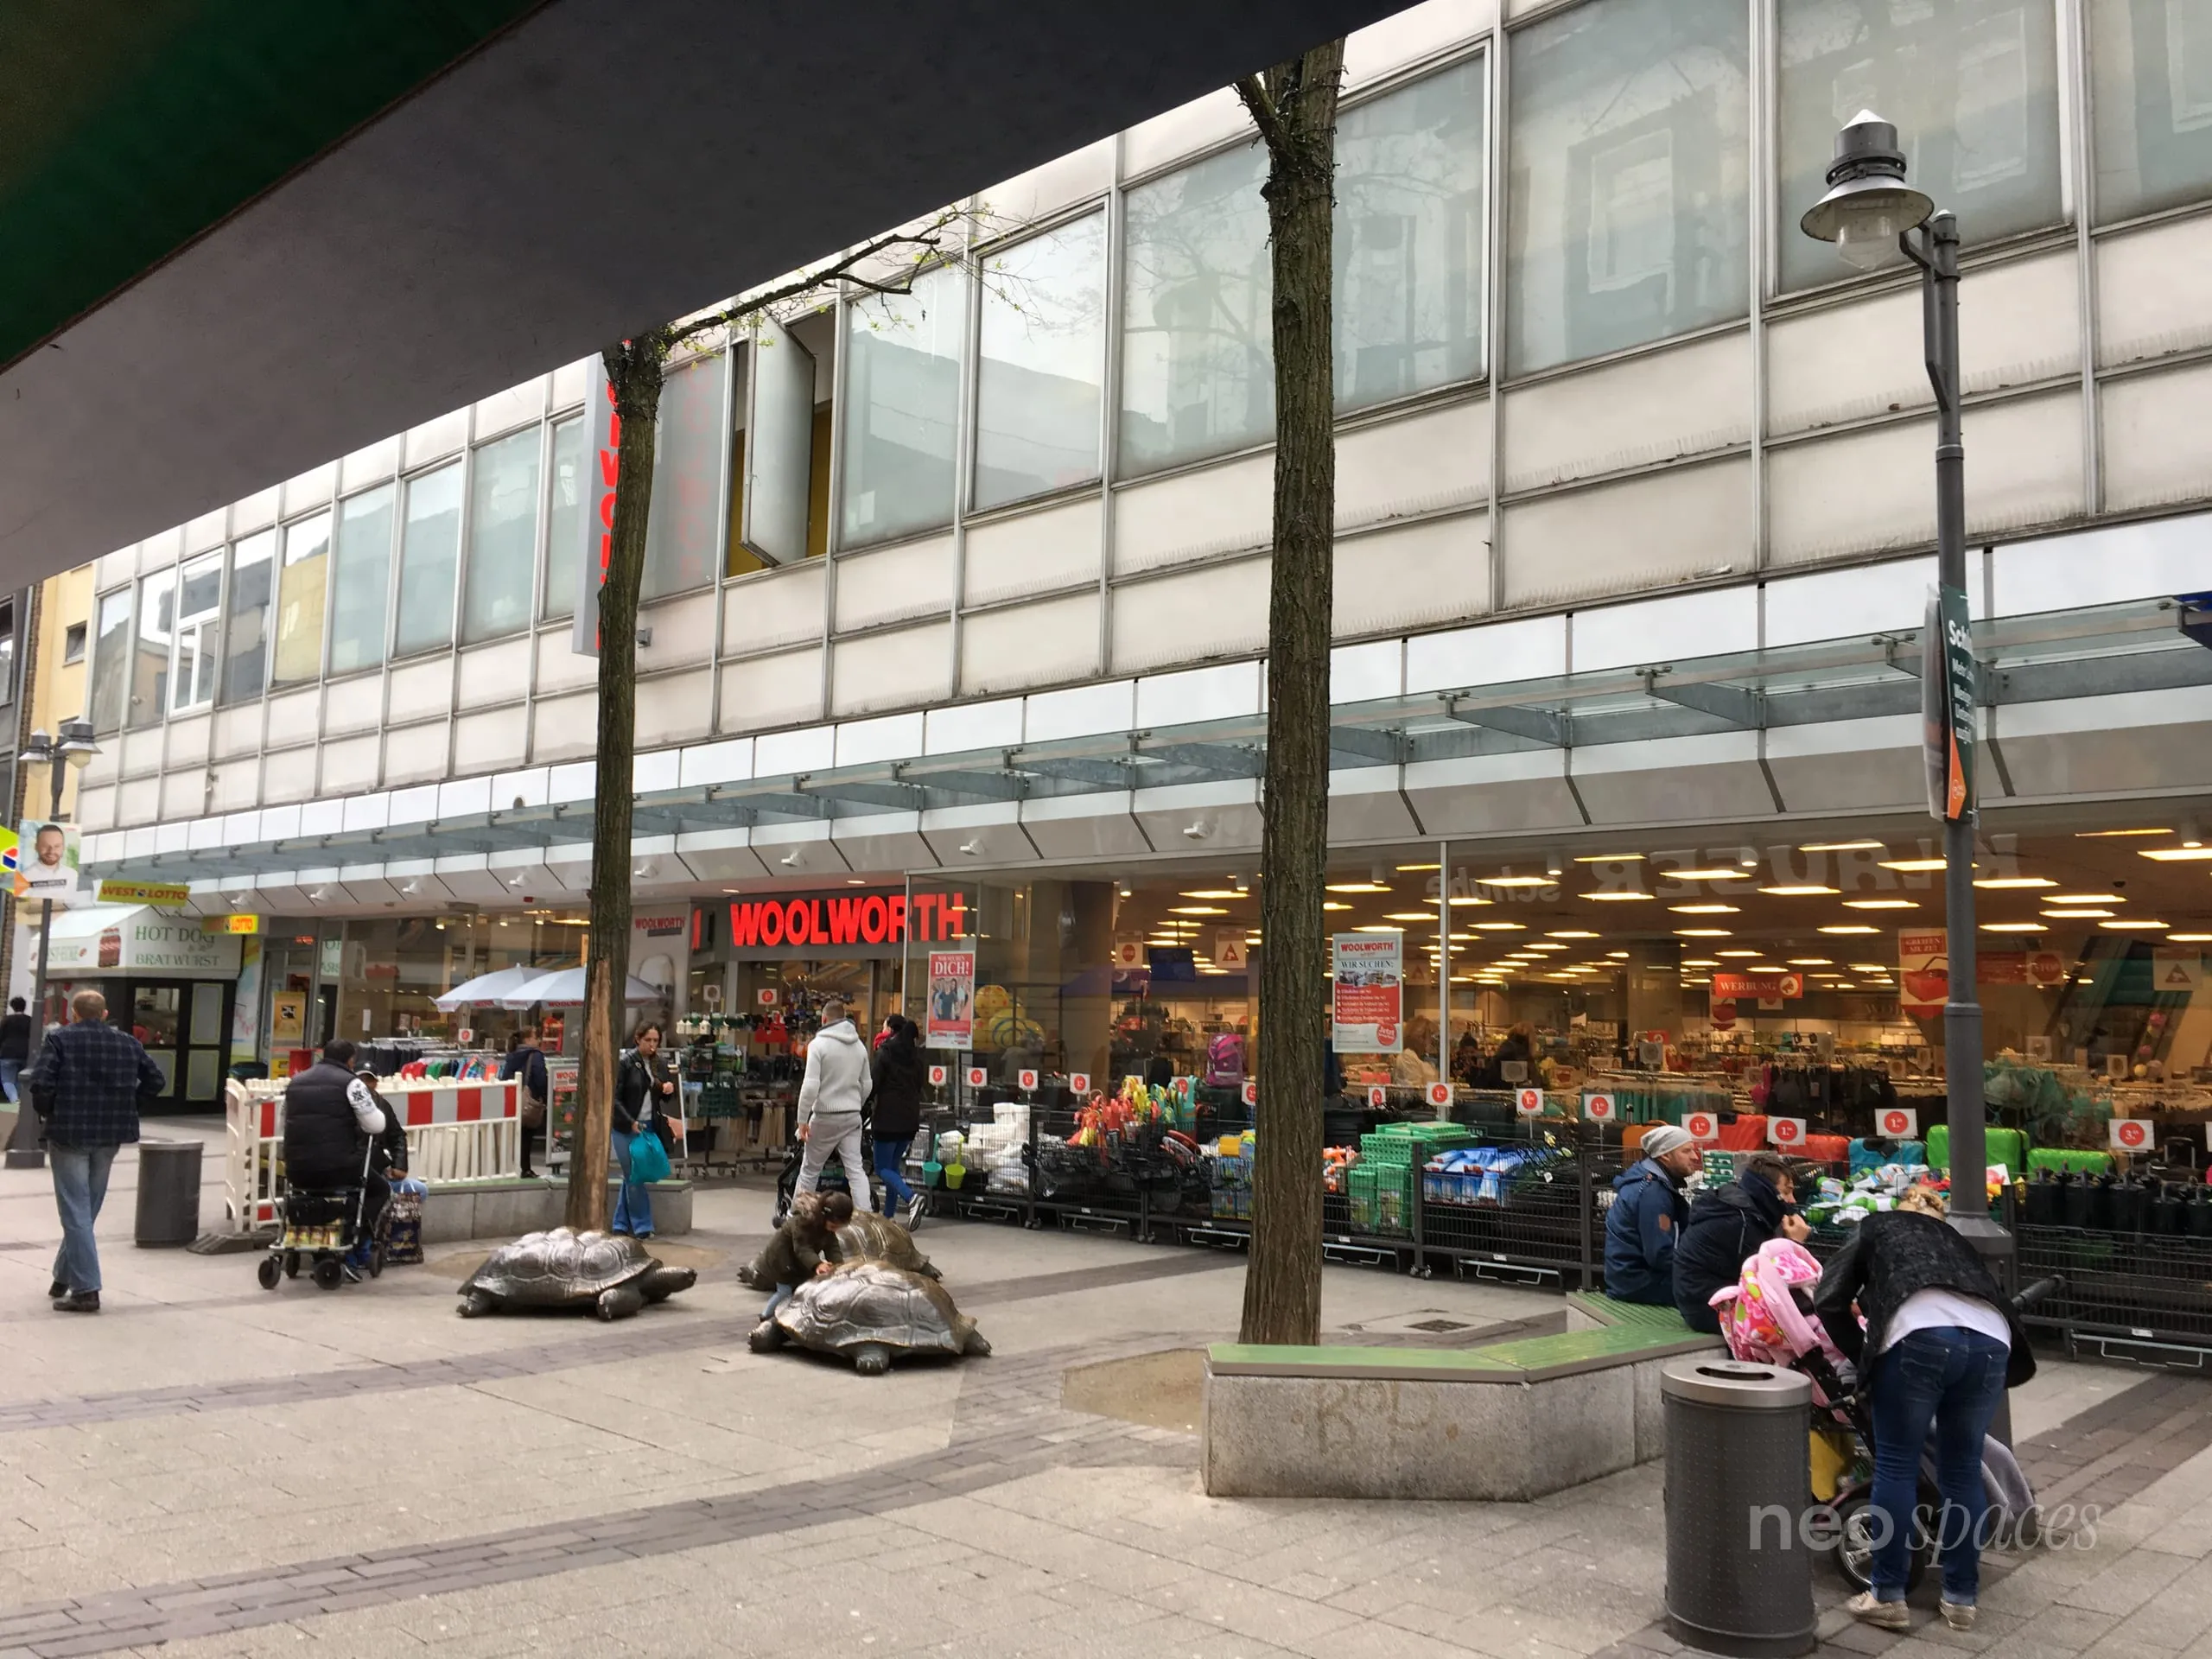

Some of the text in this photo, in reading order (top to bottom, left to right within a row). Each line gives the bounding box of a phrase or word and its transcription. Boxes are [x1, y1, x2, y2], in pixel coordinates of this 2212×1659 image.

[101, 885, 188, 900] WEST LOTTO
[635, 916, 686, 930] WOOLWORTH
[730, 893, 964, 947] WOOLWORTH
[135, 925, 215, 944] HOT DOG
[1340, 942, 1394, 952] WOOLWORTH
[135, 953, 220, 967] BRATWURST
[1341, 960, 1357, 969] WIR
[935, 961, 969, 975] DICH!
[1719, 982, 1776, 991] WERBUNG
